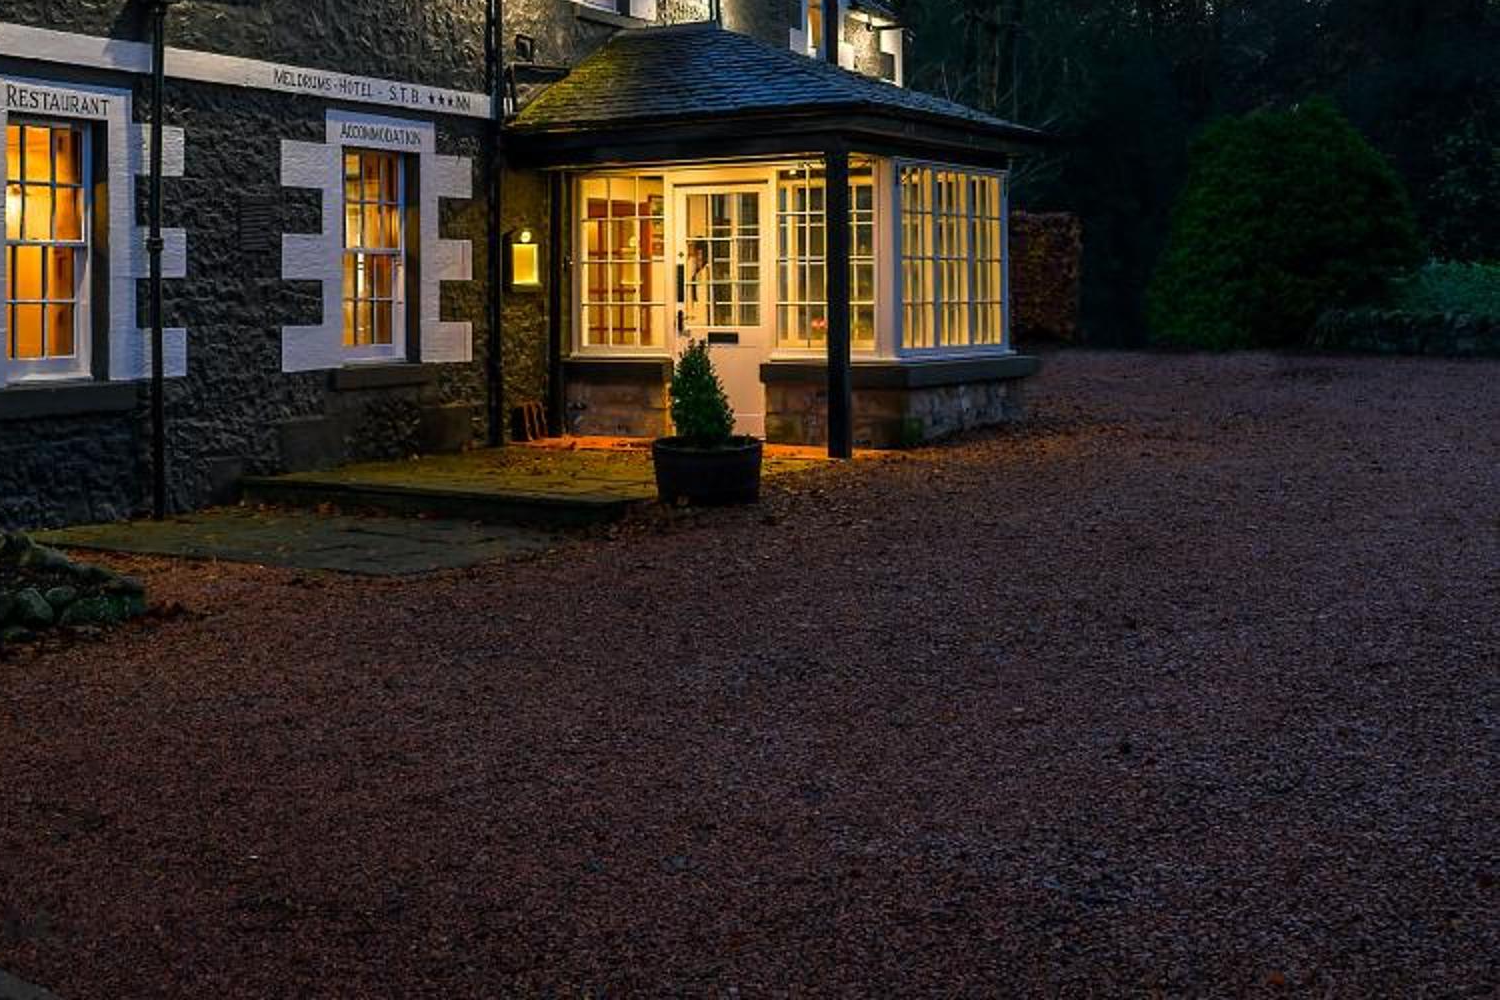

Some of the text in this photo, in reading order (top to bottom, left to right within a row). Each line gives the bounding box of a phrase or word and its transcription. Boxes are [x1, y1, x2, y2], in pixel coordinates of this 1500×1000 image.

[274, 68, 332, 91] MELDRUMS
[339, 77, 372, 97] HOTEL
[5, 83, 111, 117] RESTAURANT
[340, 122, 420, 145] ACCOMMODATION
